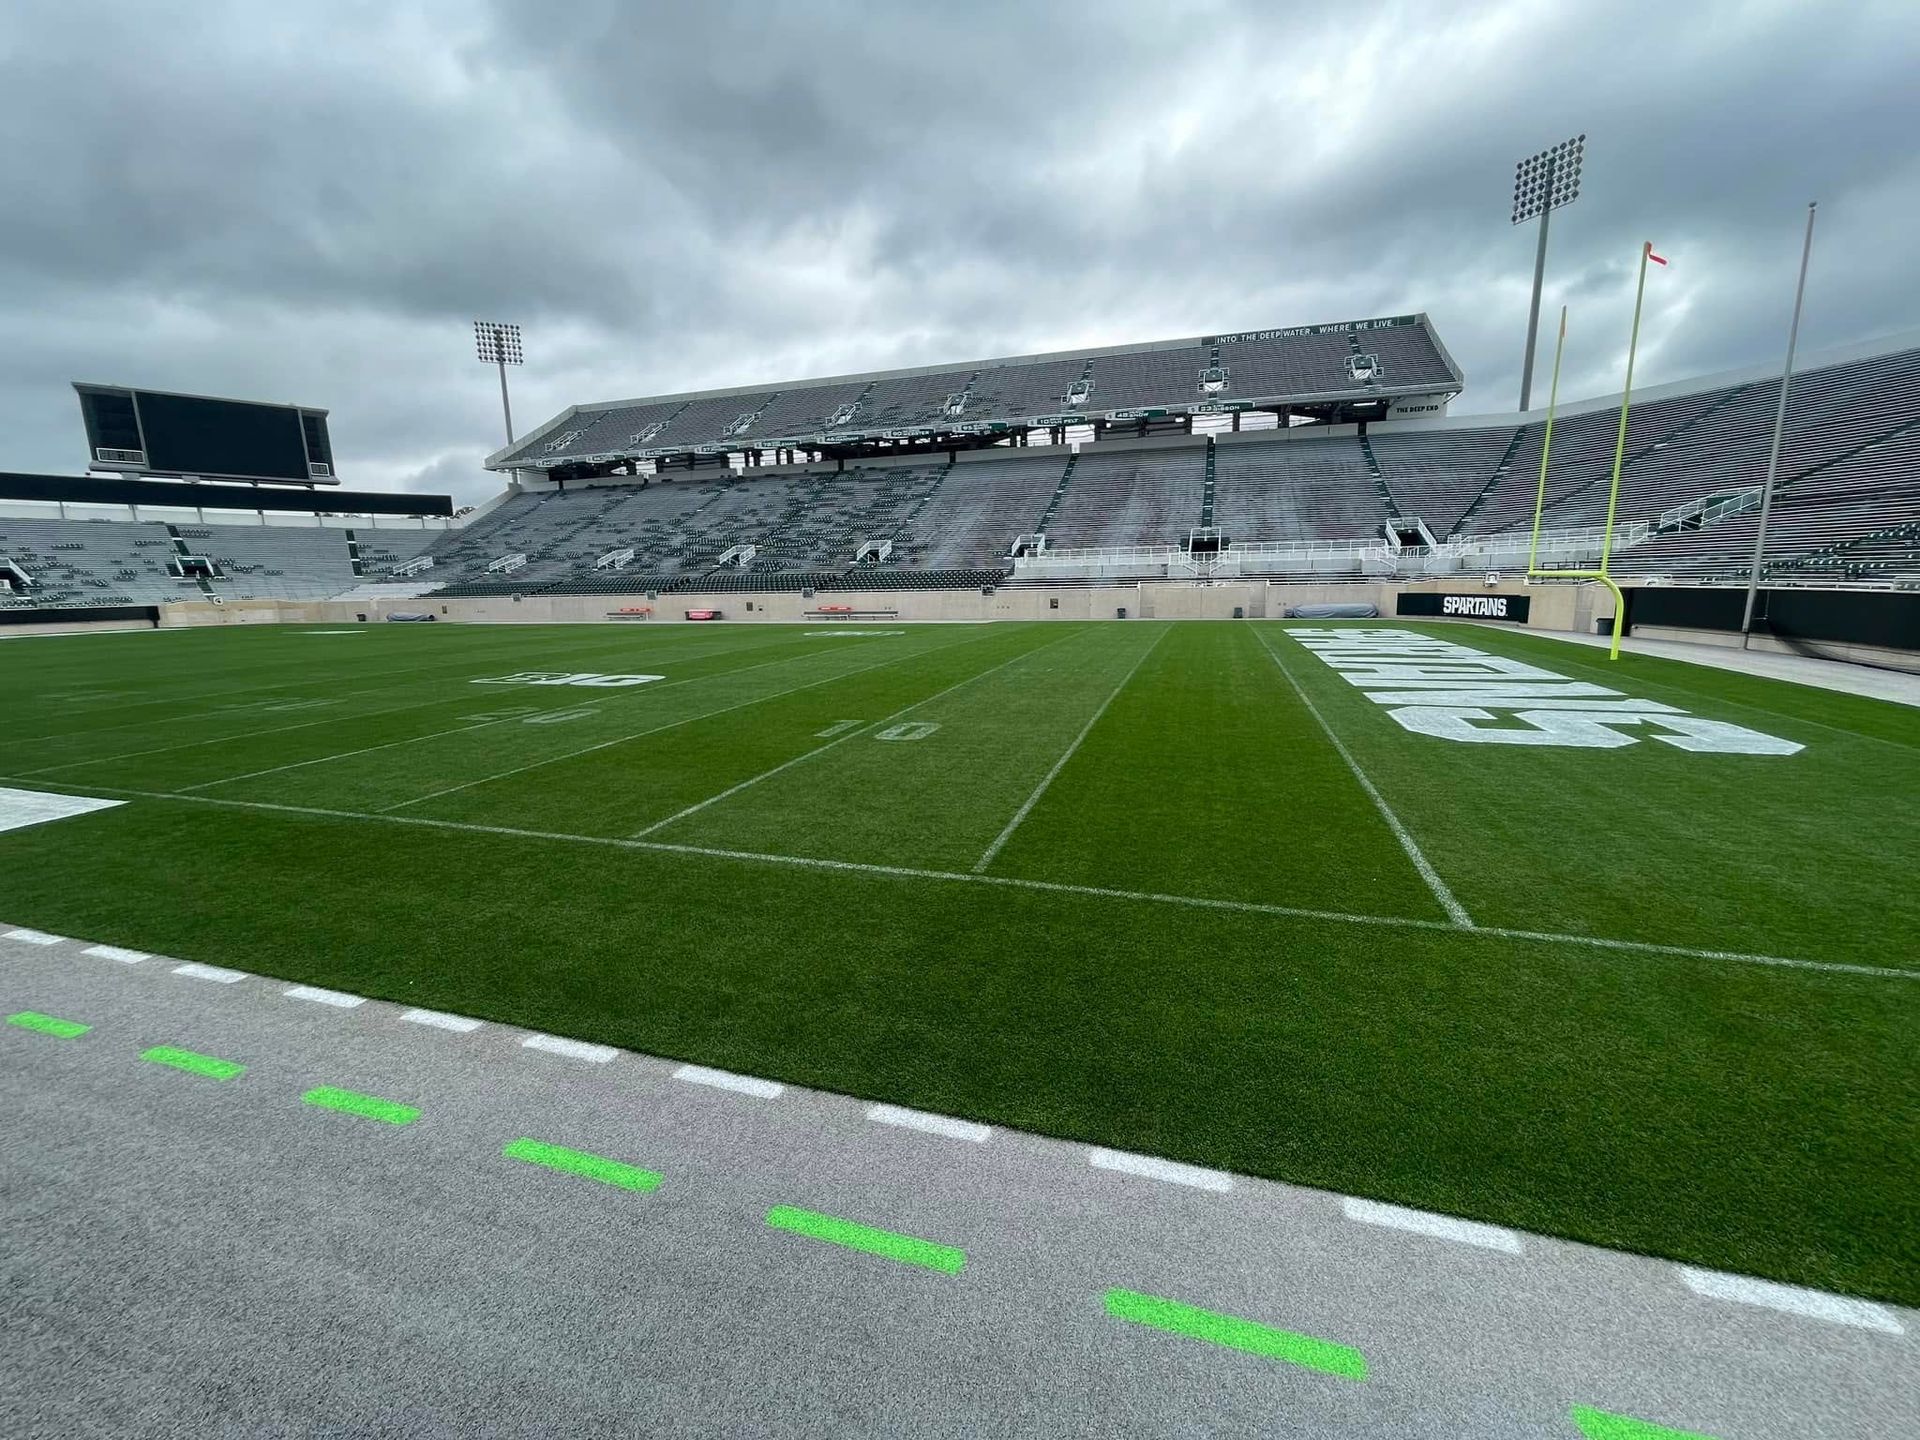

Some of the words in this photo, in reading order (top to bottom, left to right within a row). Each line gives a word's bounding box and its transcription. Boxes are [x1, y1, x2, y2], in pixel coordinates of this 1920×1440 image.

[1216, 335, 1237, 344] INTO
[1241, 333, 1257, 341] THE
[1259, 331, 1281, 340] DEEP
[1319, 323, 1350, 334] WHERE
[1355, 321, 1368, 330] WE
[1443, 596, 1507, 617] SPARTANS
